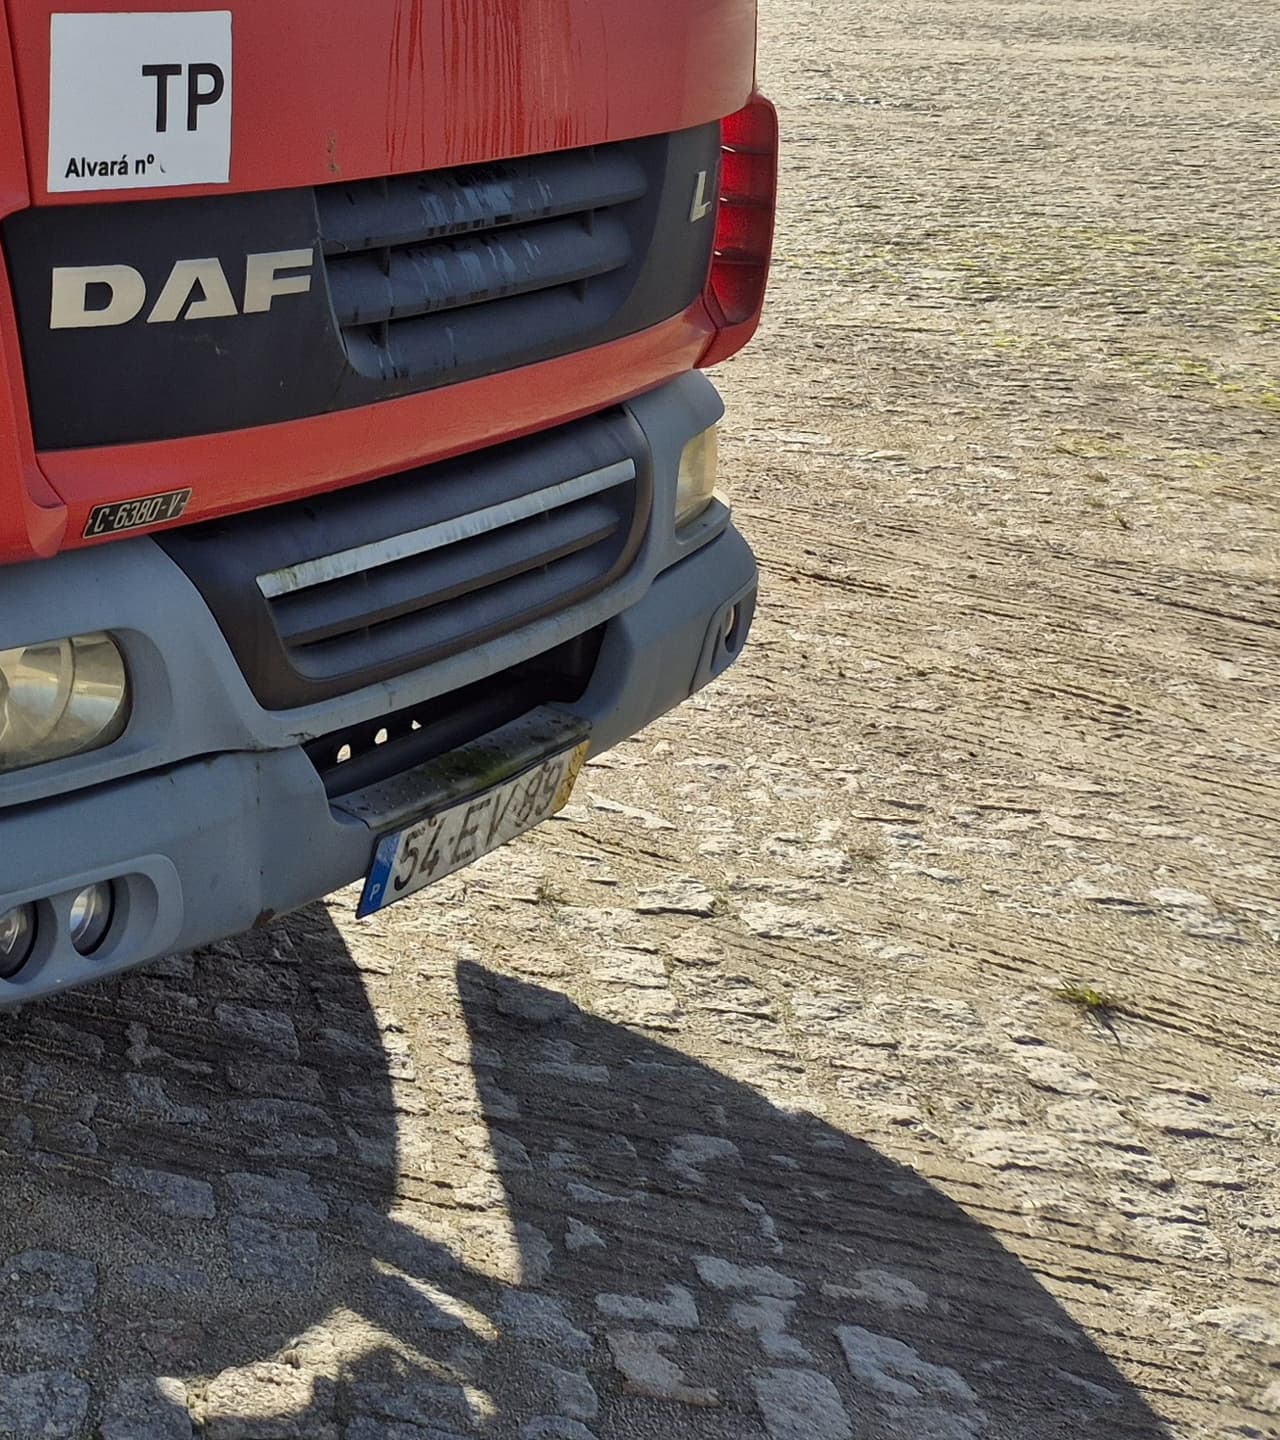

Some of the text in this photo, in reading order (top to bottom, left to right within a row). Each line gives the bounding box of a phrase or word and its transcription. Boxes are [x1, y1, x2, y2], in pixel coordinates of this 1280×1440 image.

[142, 63, 224, 132] TP
[65, 154, 128, 178] Alvará
[50, 248, 314, 329] DAF
[93, 493, 182, 533] C-6380-V
[369, 883, 381, 901] P
